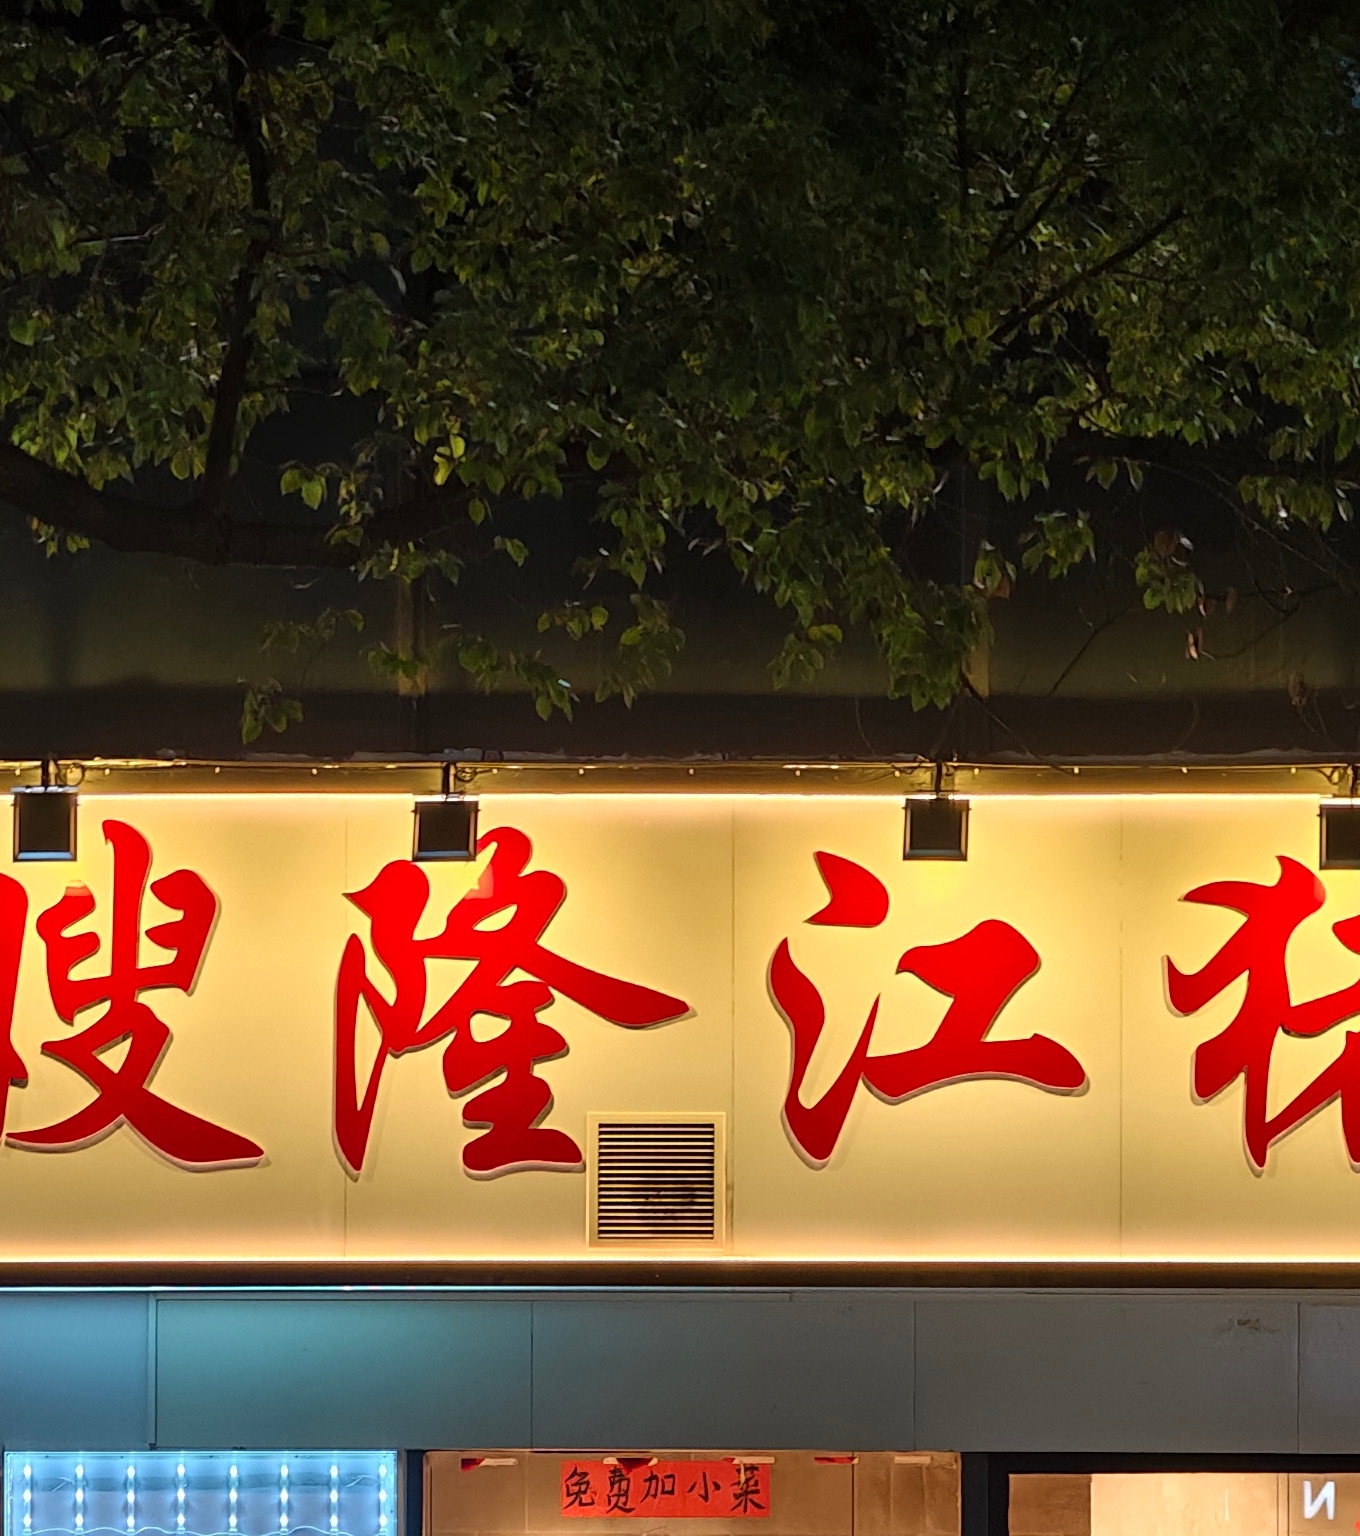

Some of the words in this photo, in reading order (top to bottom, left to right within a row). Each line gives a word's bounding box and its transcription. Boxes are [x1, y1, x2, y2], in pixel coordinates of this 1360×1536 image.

[563, 1464, 767, 1514] 免费加小菜
